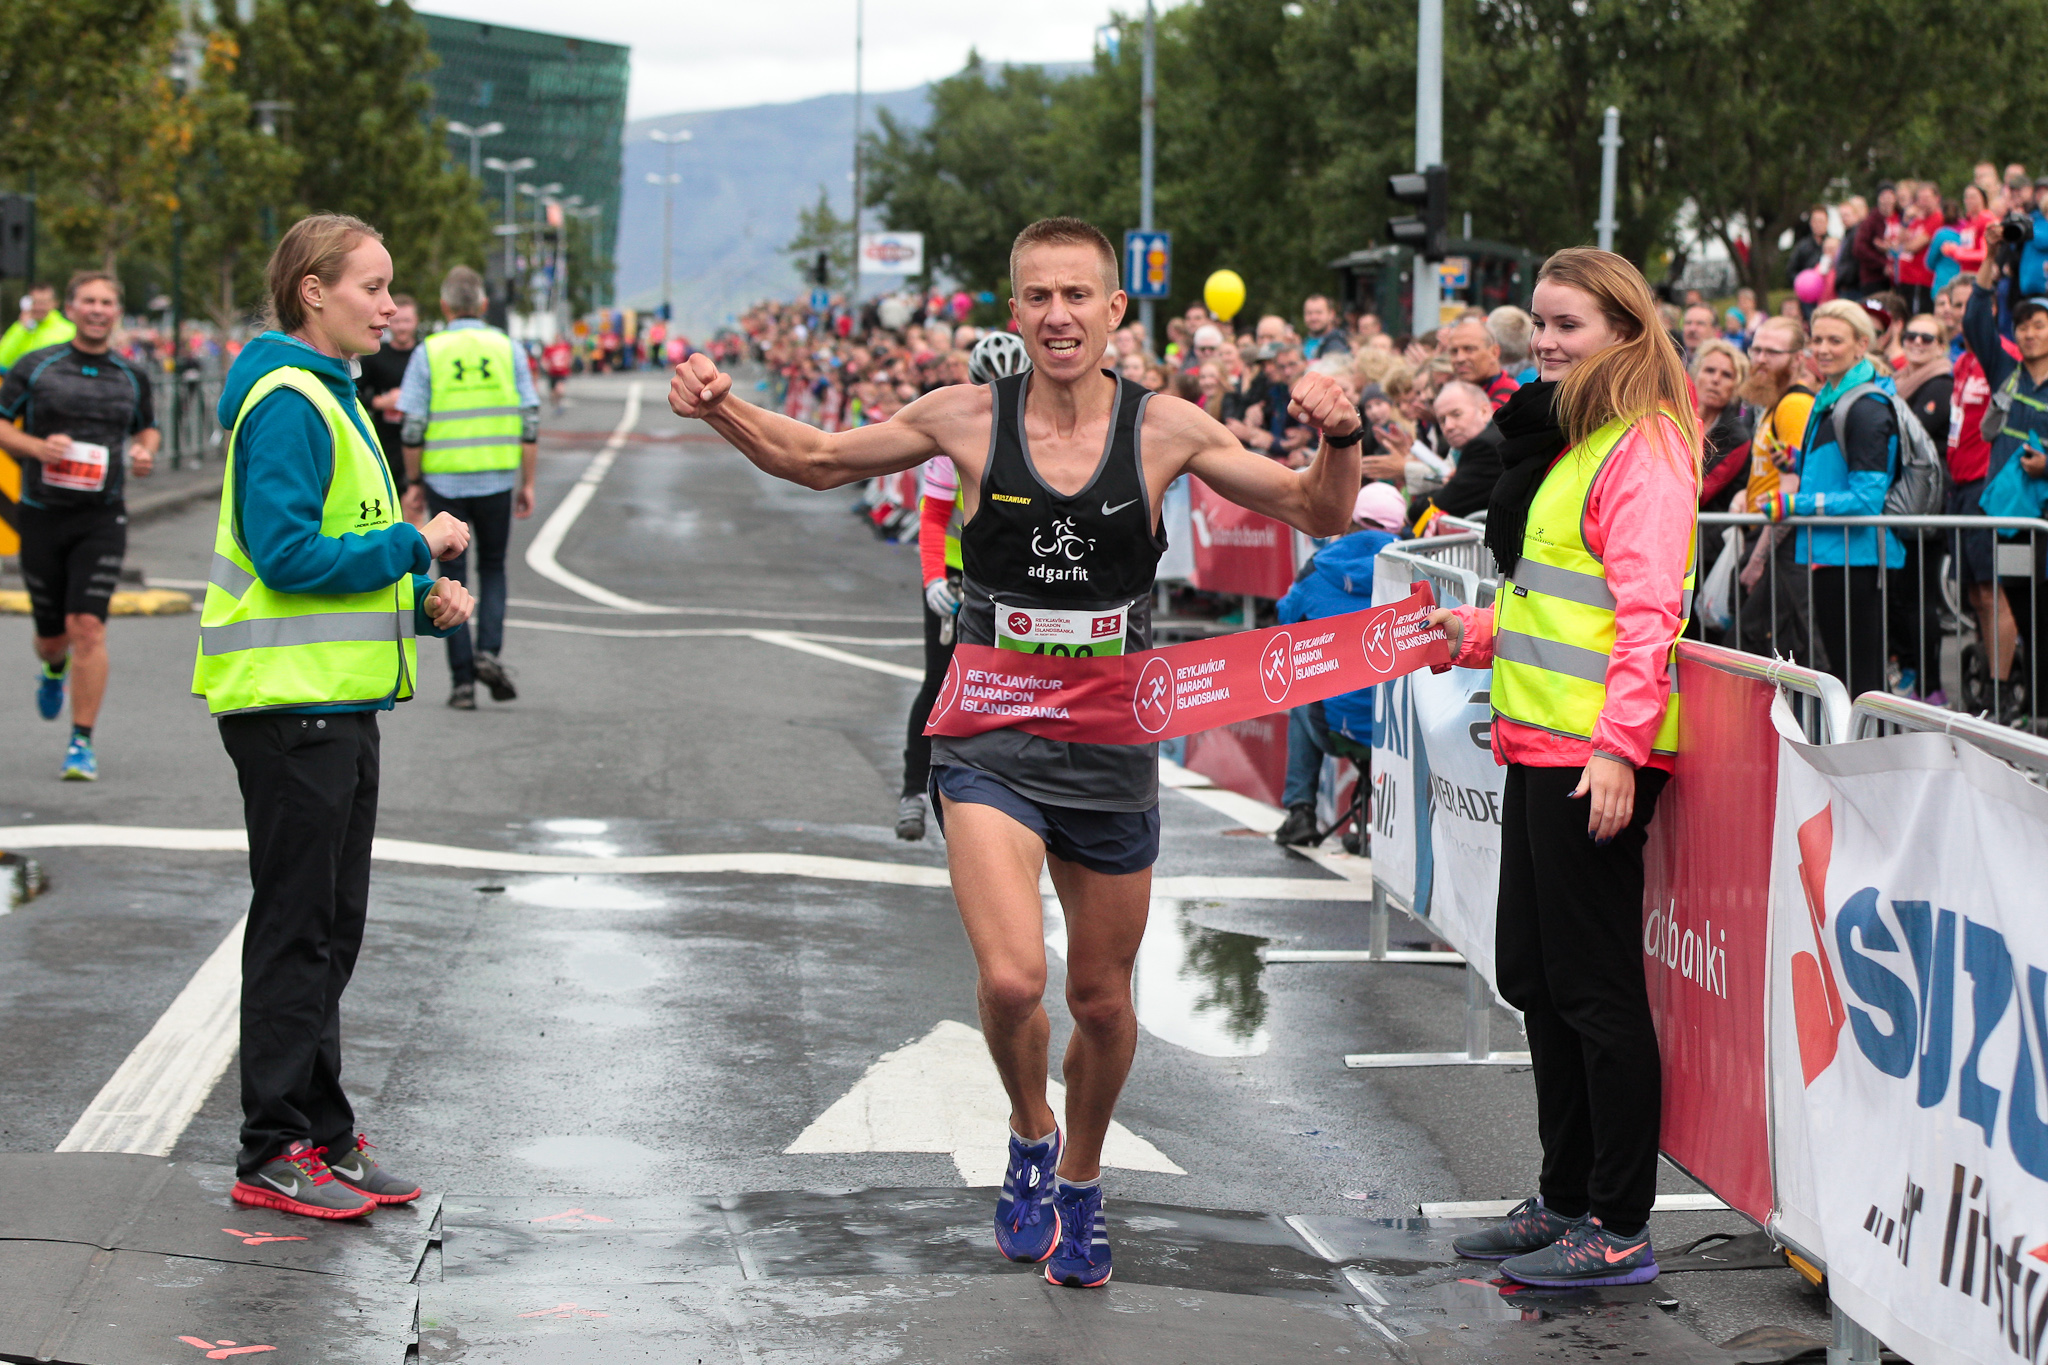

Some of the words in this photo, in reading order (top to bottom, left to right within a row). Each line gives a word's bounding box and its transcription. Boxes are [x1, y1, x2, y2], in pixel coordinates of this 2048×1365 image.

[1028, 564, 1089, 584] adgarfit
[1293, 632, 1335, 652] REYKJAVÍKUR
[1293, 648, 1323, 666] MARAÞON
[966, 669, 1063, 690] REYKJAVÍKUR
[1176, 659, 1226, 680] REYKJAVÍKUR
[1295, 658, 1340, 681] ÍSLANDSBANKA
[963, 684, 1034, 703] MARAÞON
[1176, 676, 1213, 695] MARAÞON
[960, 696, 1070, 719] ÍSLANDSBANKA
[1176, 687, 1230, 710] ÍSLANDSBANKA
